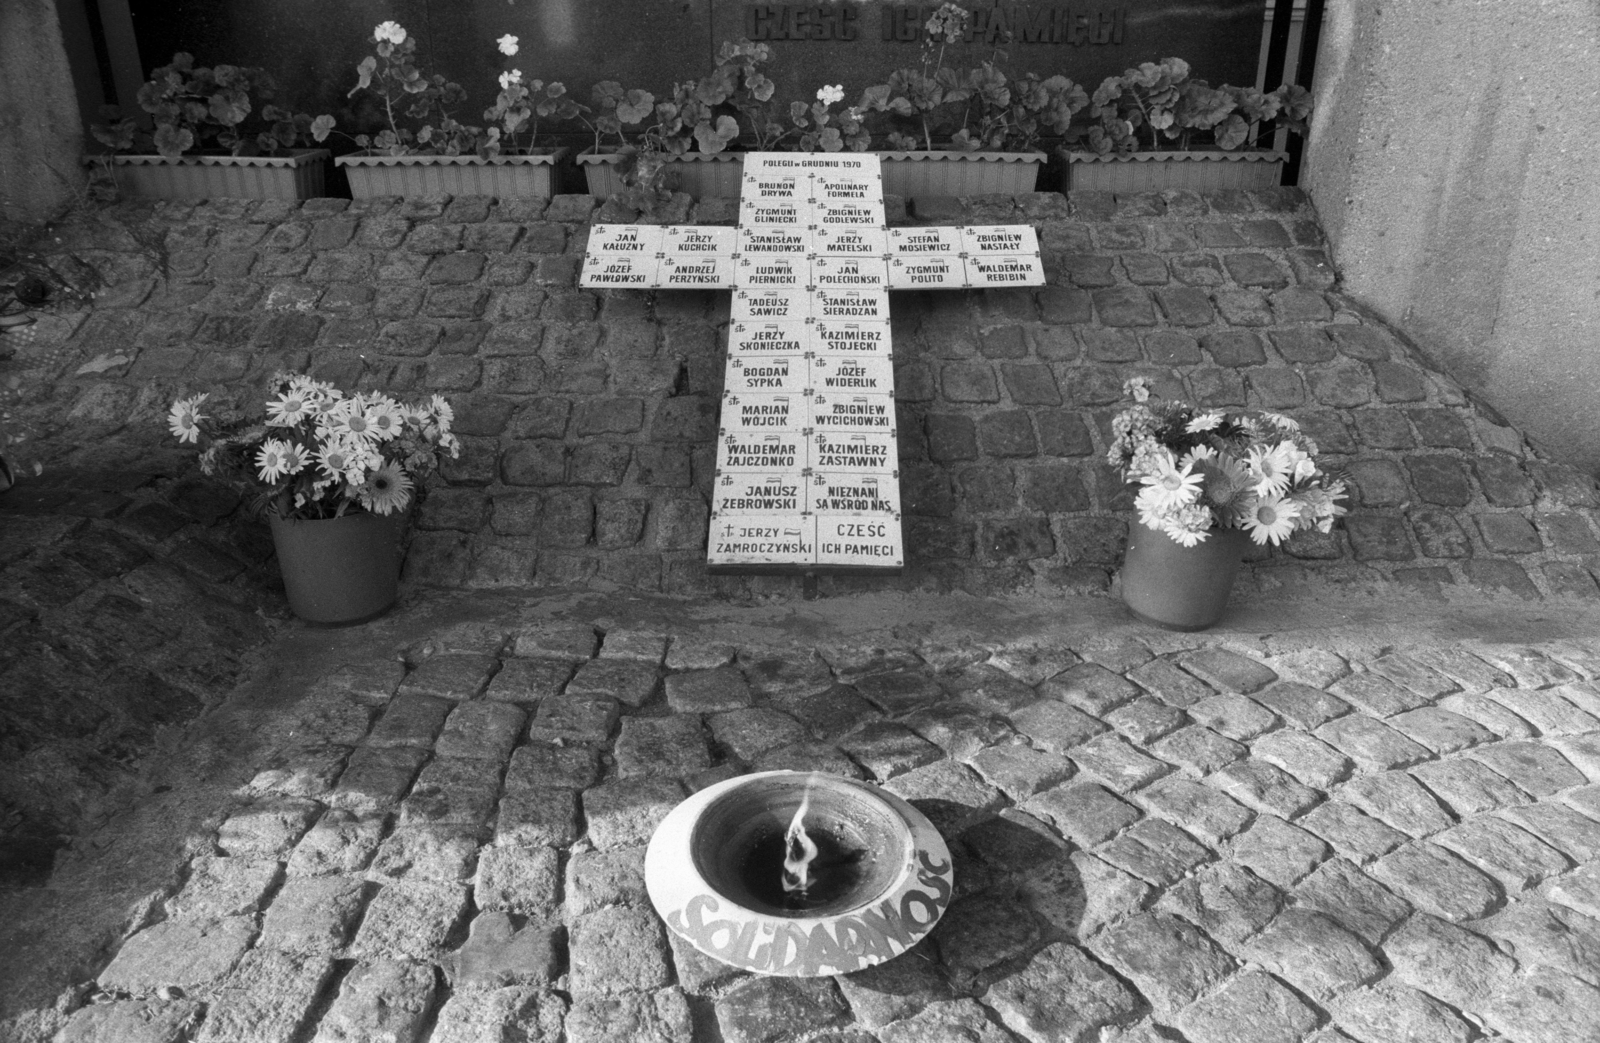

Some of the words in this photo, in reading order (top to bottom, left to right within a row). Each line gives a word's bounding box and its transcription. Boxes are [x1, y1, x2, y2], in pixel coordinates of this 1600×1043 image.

[802, 160, 839, 168] GRUDNIU
[842, 160, 861, 168] 1970
[758, 182, 795, 190] BRUNON
[824, 183, 869, 191] APOLINARY
[827, 190, 865, 198] FORMELA
[755, 208, 797, 216] ZYGMUNT
[823, 216, 874, 224] GODLEWSKI
[614, 234, 637, 242] JAN
[684, 234, 713, 243] JERZY
[750, 236, 802, 244] STANISŁAW
[835, 236, 863, 244] JERZY
[907, 236, 940, 244] STEFAN
[976, 234, 1022, 242] ZBIGNIEW
[678, 243, 717, 252] KUCHCIK
[744, 244, 805, 253] LEWANDOWSKI
[827, 244, 872, 252] MATELSKI
[899, 243, 951, 252] MOSIEWICZ
[980, 242, 1020, 250] NASTAŁY
[603, 264, 633, 274] JÓZEF
[674, 265, 716, 274] ANDRZEJ
[756, 266, 793, 275] LUDWIK
[837, 266, 859, 274] JAN
[905, 265, 950, 274] ZYGMUNT
[978, 264, 1032, 273] WALDEMAR
[749, 276, 796, 284] PIERNICKI
[819, 274, 881, 284] POLECHOŃSKI
[911, 274, 944, 283] POLITO
[986, 273, 1026, 282] REBIBIN
[748, 298, 789, 306] TADEUSZ
[822, 298, 877, 307] STANISŁAW
[749, 307, 788, 316] SAWICZ
[823, 307, 878, 316] SIERADZAN
[751, 332, 785, 340] JERZY
[820, 330, 882, 341] KAZIMIERZ
[739, 341, 800, 350] SKONIECZKA
[827, 341, 877, 351] STOJECKI
[743, 367, 788, 377] BOGDAN
[836, 366, 867, 377] JÓZEF
[746, 378, 783, 388] SYPKA
[825, 378, 877, 388] WIDERLIK
[742, 405, 789, 415] MARIAN
[832, 404, 885, 415] ZBIGNIEW
[741, 415, 787, 426] WÓJCIK
[815, 415, 889, 426] WYCICHOWSKI
[727, 444, 796, 455] WALDEMAR
[819, 444, 887, 456] KAZIMIERZ
[818, 455, 886, 467] ZASTAWNY
[745, 486, 798, 497] JANUSZ
[828, 486, 878, 498] NIEZNANI
[722, 496, 797, 510] ŻEBROWSKI
[871, 500, 891, 511] NAS
[739, 527, 780, 538] JERZY
[837, 520, 886, 538] CZEŚĆ
[822, 543, 841, 554] ICH
[844, 544, 894, 557] PAMIĘCI
